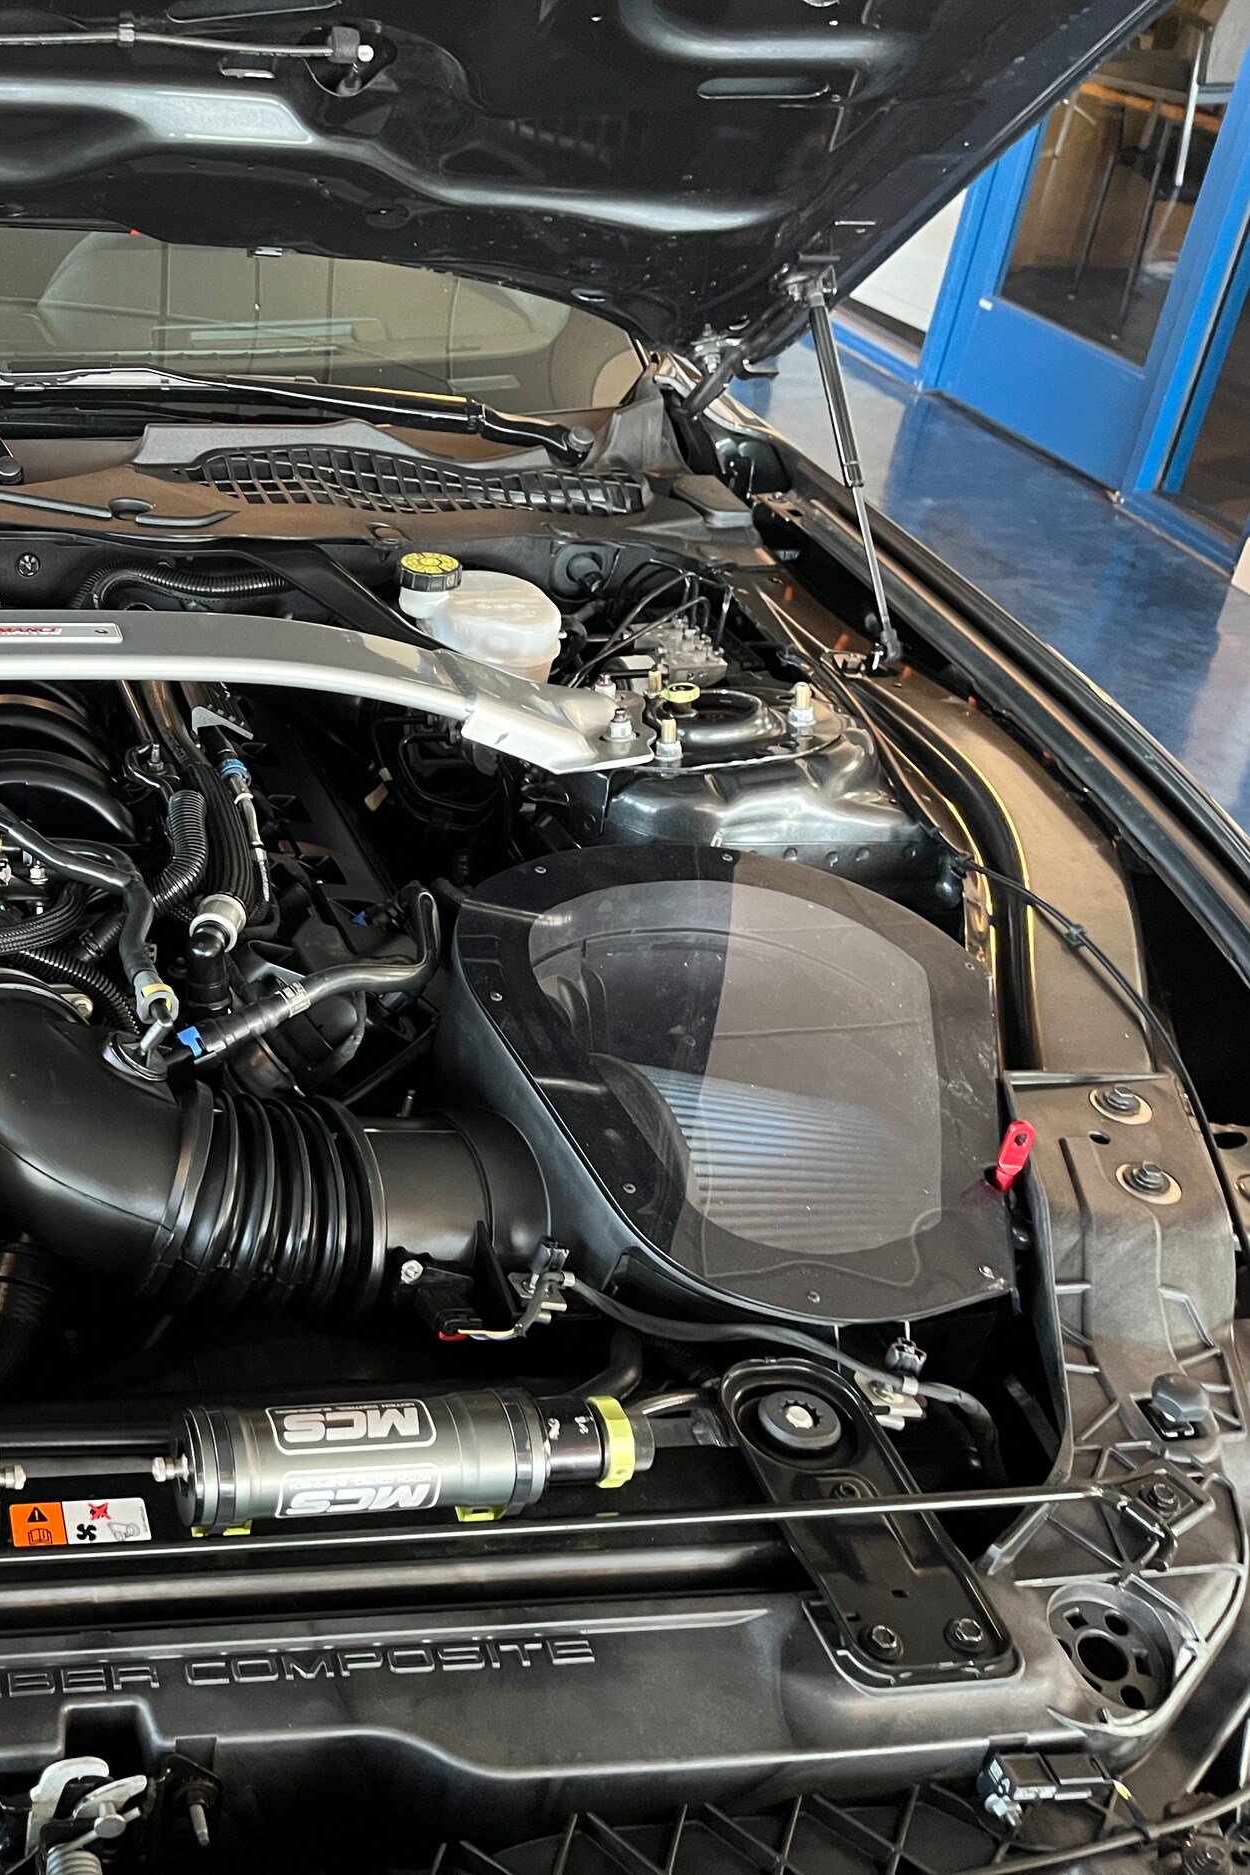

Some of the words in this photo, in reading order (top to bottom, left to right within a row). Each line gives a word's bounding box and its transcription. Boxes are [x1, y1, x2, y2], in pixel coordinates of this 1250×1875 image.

[283, 1407, 420, 1443] MCS
[285, 1483, 431, 1515] MCS
[184, 1639, 596, 1686] COMPOSITE
